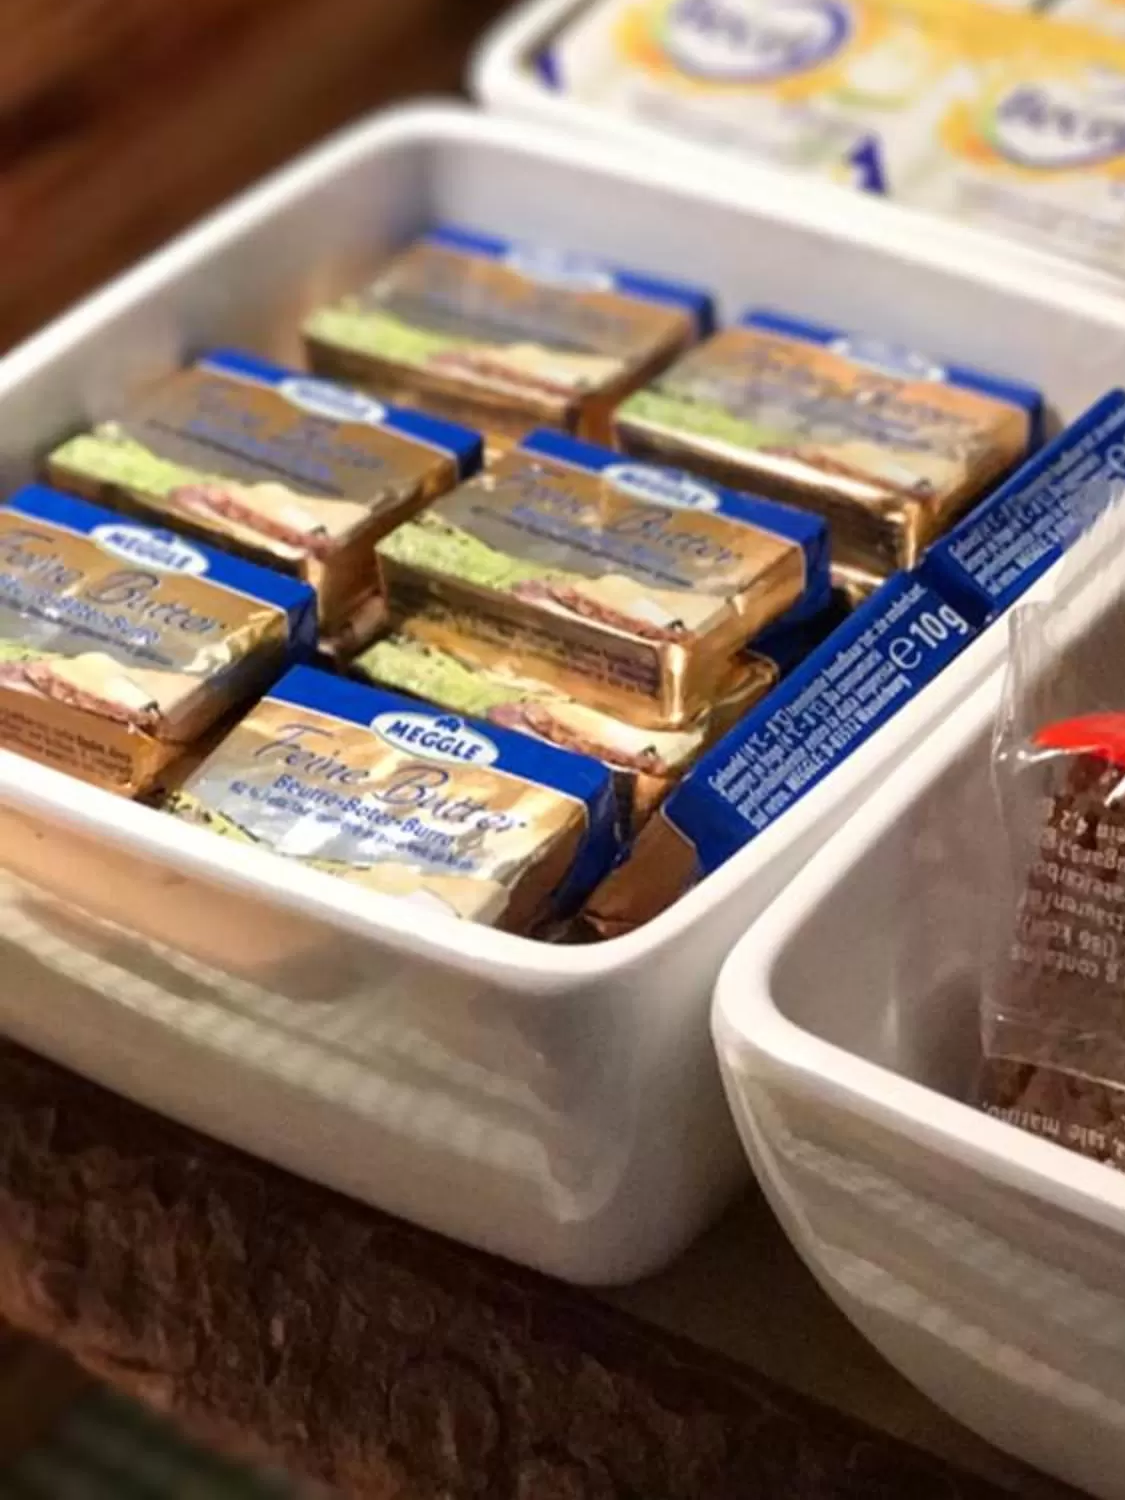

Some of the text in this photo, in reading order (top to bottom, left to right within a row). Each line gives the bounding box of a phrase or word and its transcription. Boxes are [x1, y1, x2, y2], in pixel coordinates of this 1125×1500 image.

[387, 721, 483, 759] MEGGLE
[253, 723, 371, 785] Feine
[375, 765, 528, 833] Butter
